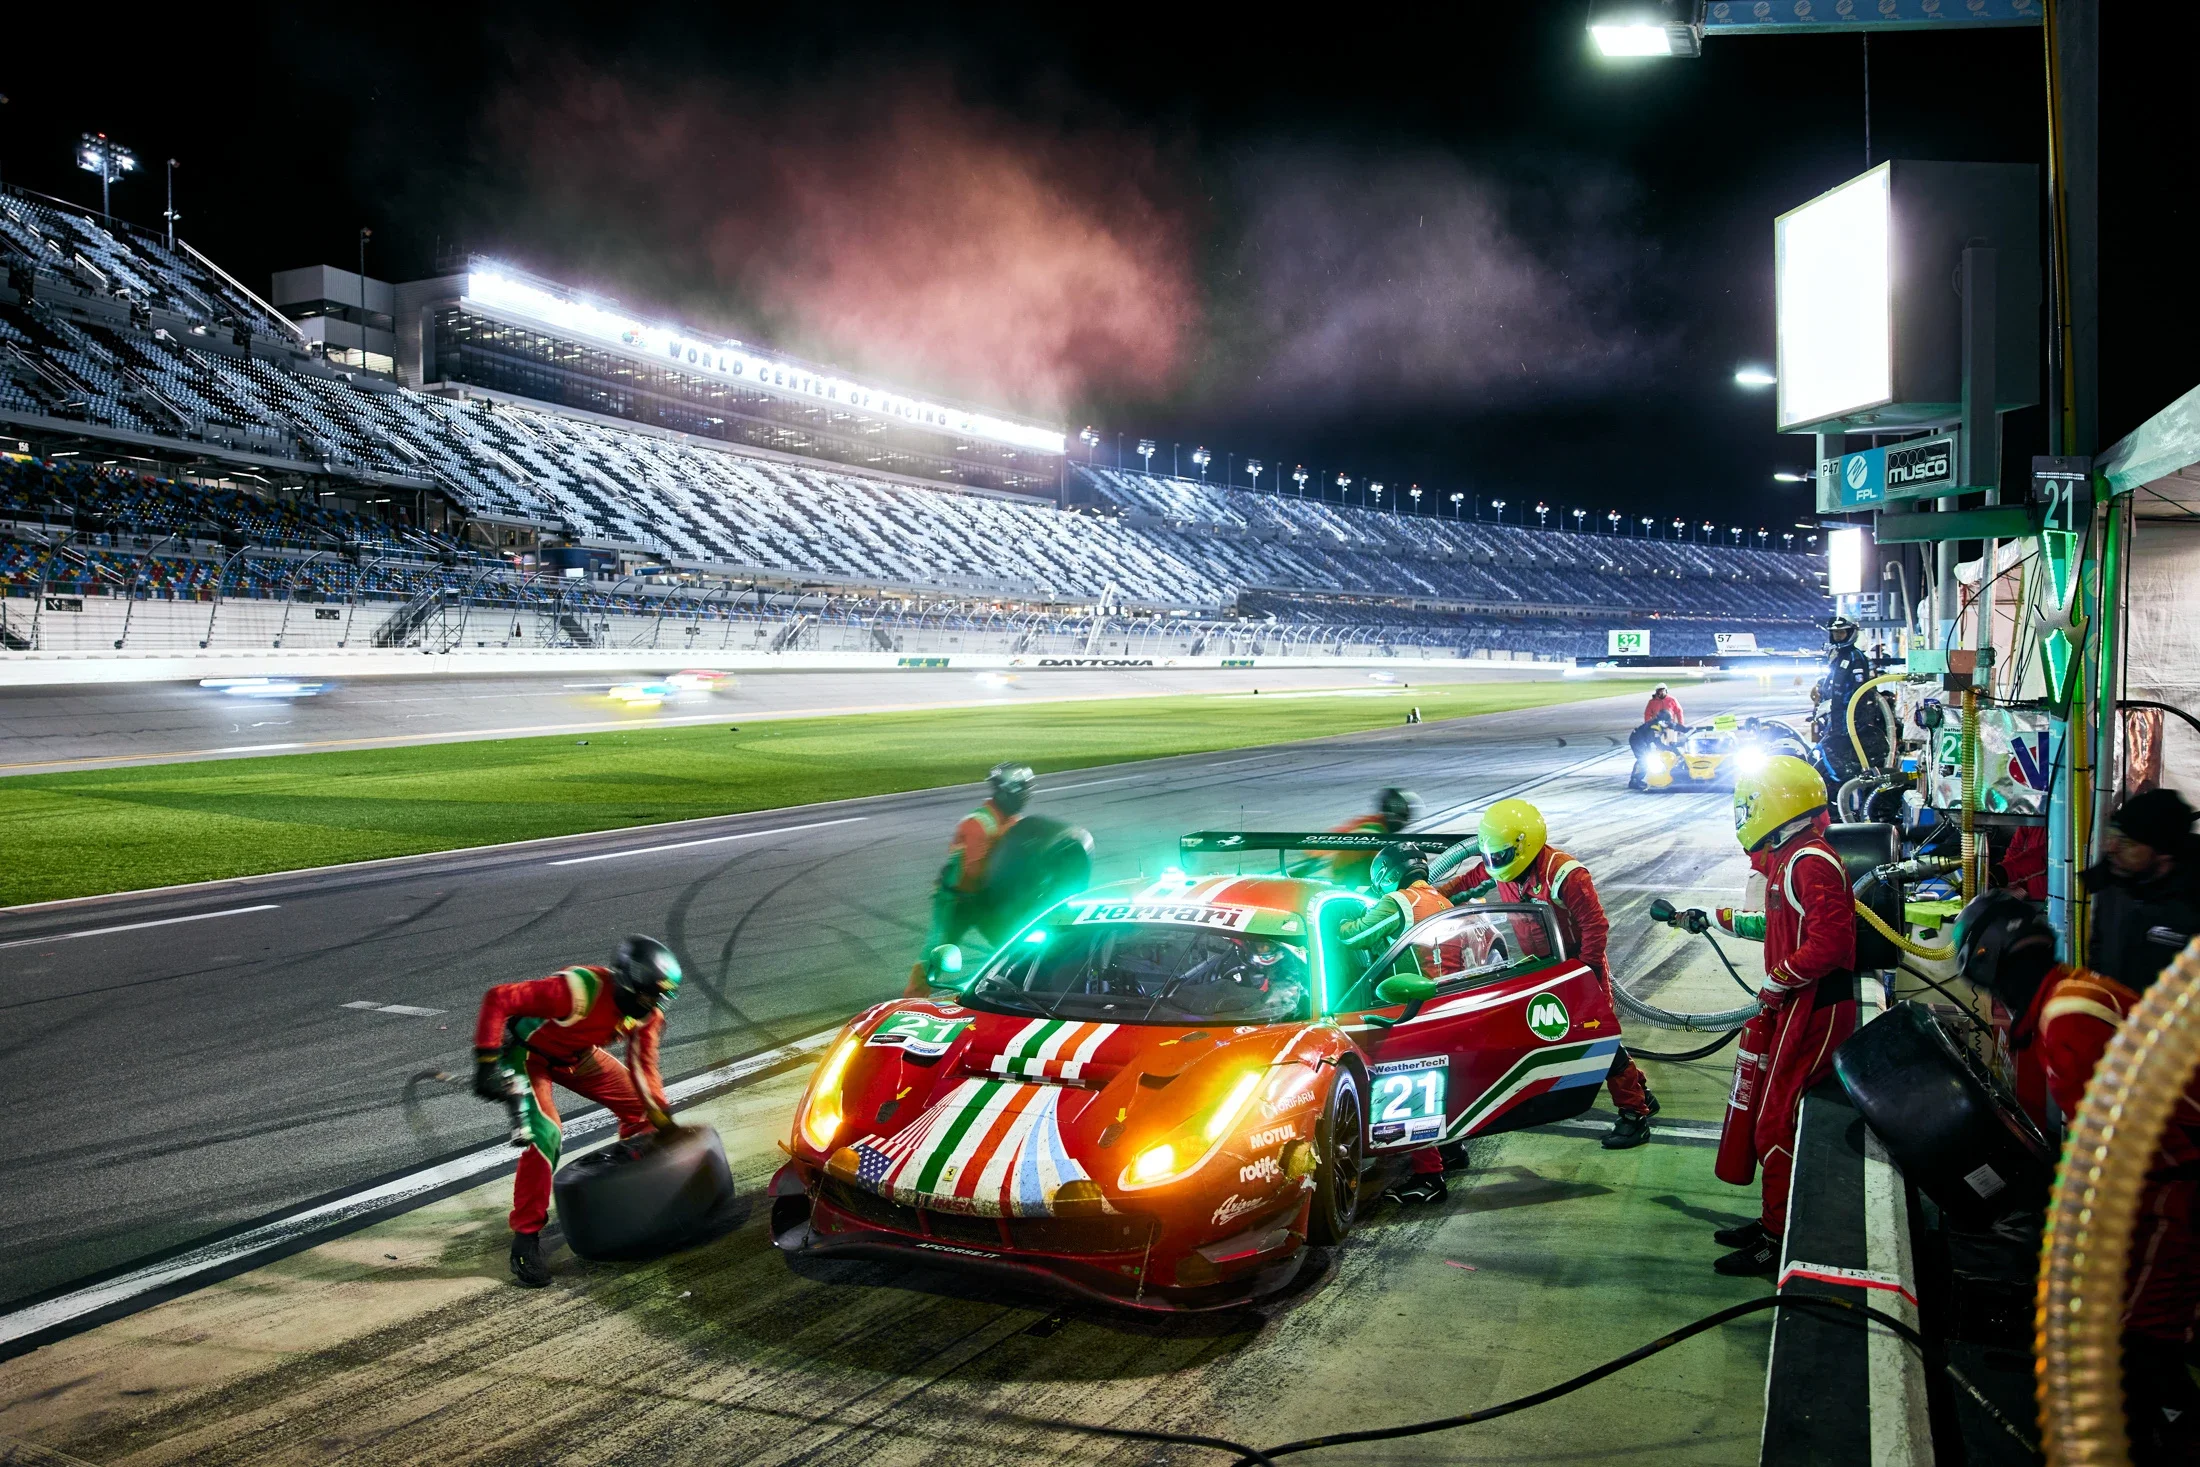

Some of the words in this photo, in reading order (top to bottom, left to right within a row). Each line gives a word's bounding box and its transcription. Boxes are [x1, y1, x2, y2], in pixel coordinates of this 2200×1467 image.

[669, 341, 743, 375] WORLD
[759, 367, 836, 399] CENTER
[851, 391, 871, 407] OF
[882, 399, 946, 426] RACING
[1822, 462, 1839, 477] P47
[1856, 488, 1877, 501] FPL
[2044, 480, 2073, 530] 21
[1619, 634, 1638, 647] 32
[1717, 634, 1731, 643] 57
[1037, 659, 1154, 667] DAYTONA
[1083, 903, 1242, 928] Ferrari
[888, 1016, 956, 1043] 21
[1375, 1058, 1446, 1074] WeatherTech
[1278, 1090, 1316, 1112] ORIFARM
[1382, 1070, 1437, 1121] 21
[1250, 1124, 1297, 1150] MOTUL
[915, 1242, 1001, 1259] AFCORSE.IT
